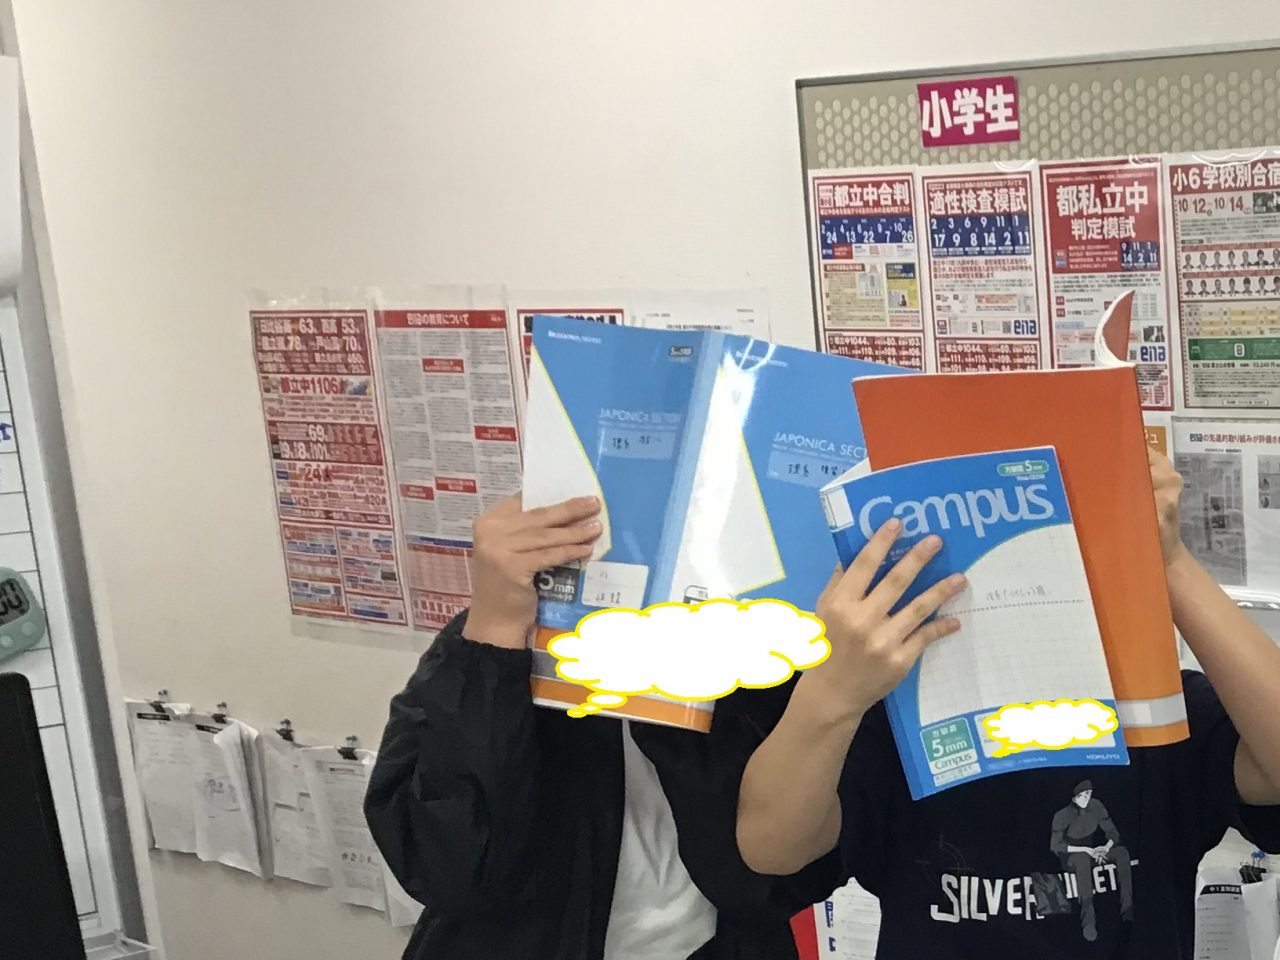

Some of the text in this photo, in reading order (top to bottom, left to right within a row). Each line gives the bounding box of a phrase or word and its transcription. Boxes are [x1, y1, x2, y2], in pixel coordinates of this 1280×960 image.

[922, 85, 1019, 138] 小学生
[834, 181, 910, 207] 都立中合判
[929, 188, 1027, 216] 適性検査模試
[1056, 181, 1149, 217] 都私立中
[1071, 216, 1136, 240] 判定模試
[1013, 319, 1037, 336] ena
[1140, 346, 1166, 362] ena
[773, 431, 836, 452] JAPONICA
[858, 481, 1057, 541] Campus
[934, 753, 973, 771] Campus
